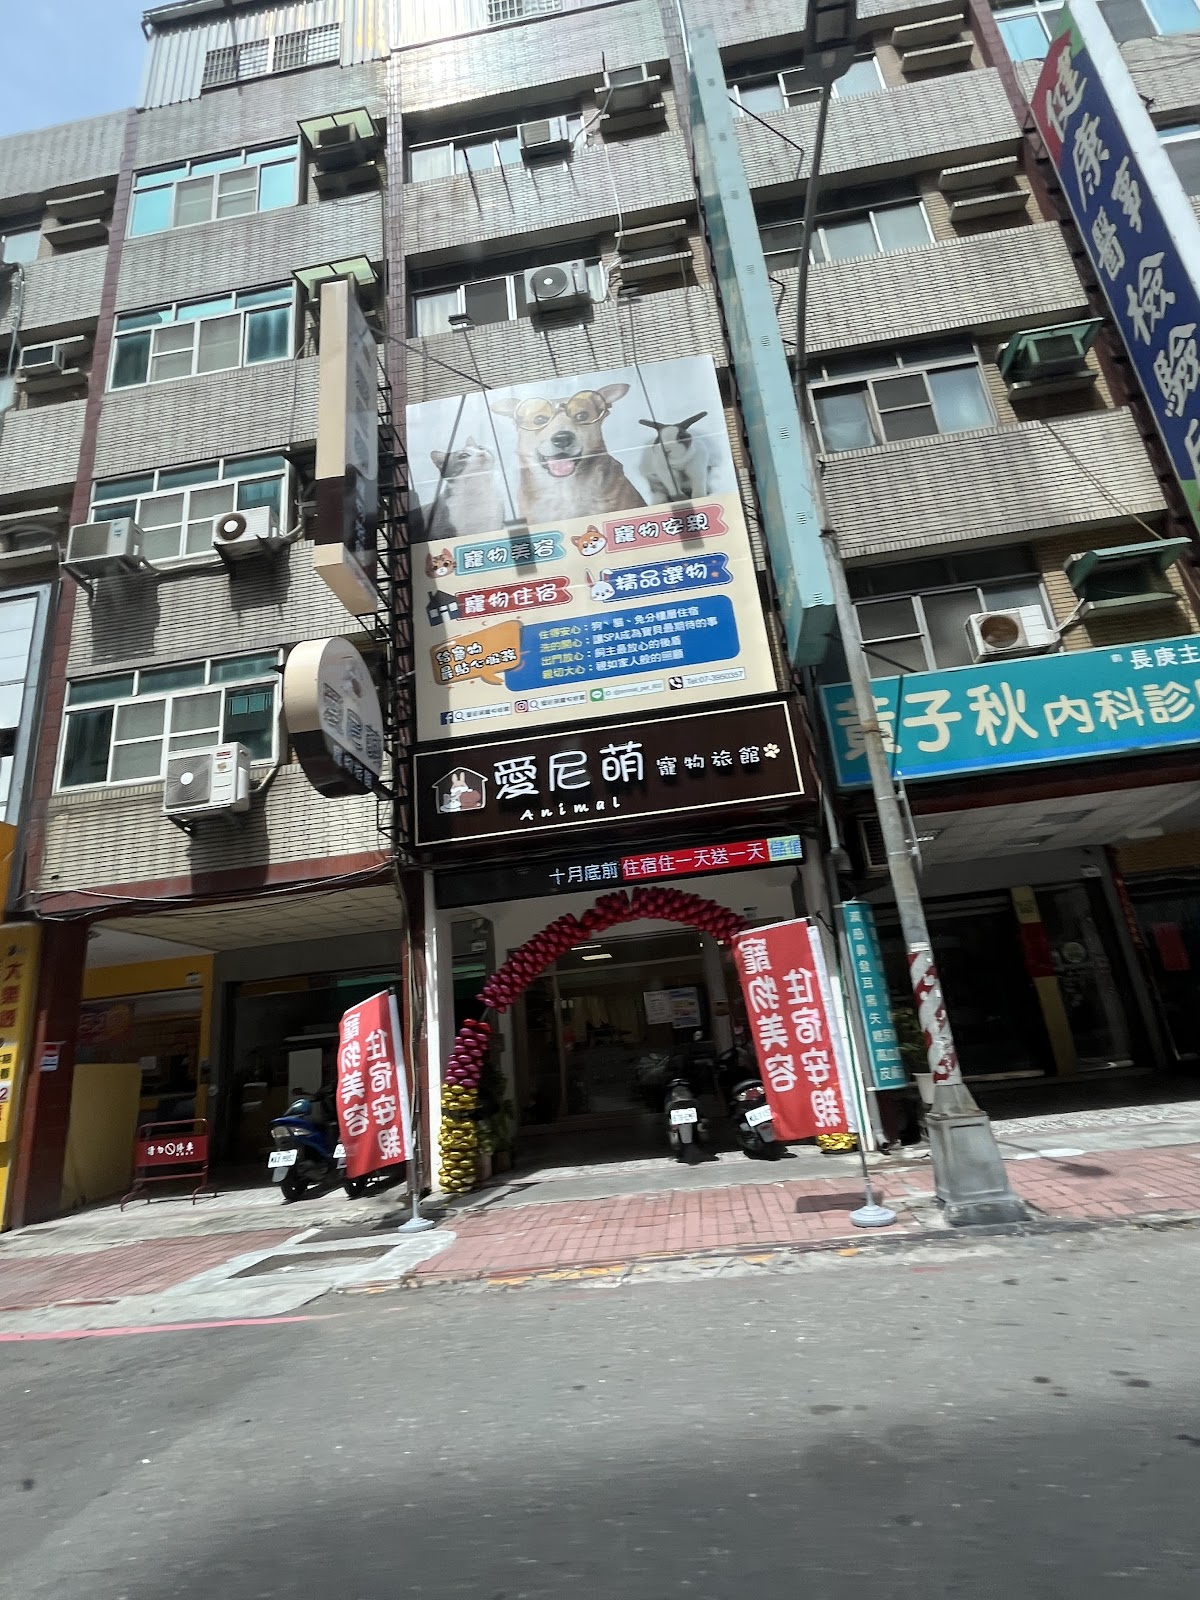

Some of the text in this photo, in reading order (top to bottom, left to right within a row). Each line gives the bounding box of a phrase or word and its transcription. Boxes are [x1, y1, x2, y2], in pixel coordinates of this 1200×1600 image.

[613, 512, 710, 544] 寵物安親
[463, 538, 555, 569] 寵物美容
[615, 562, 708, 592] 精品選物
[464, 582, 558, 614] 寵物住宿
[519, 796, 621, 822] Animal
